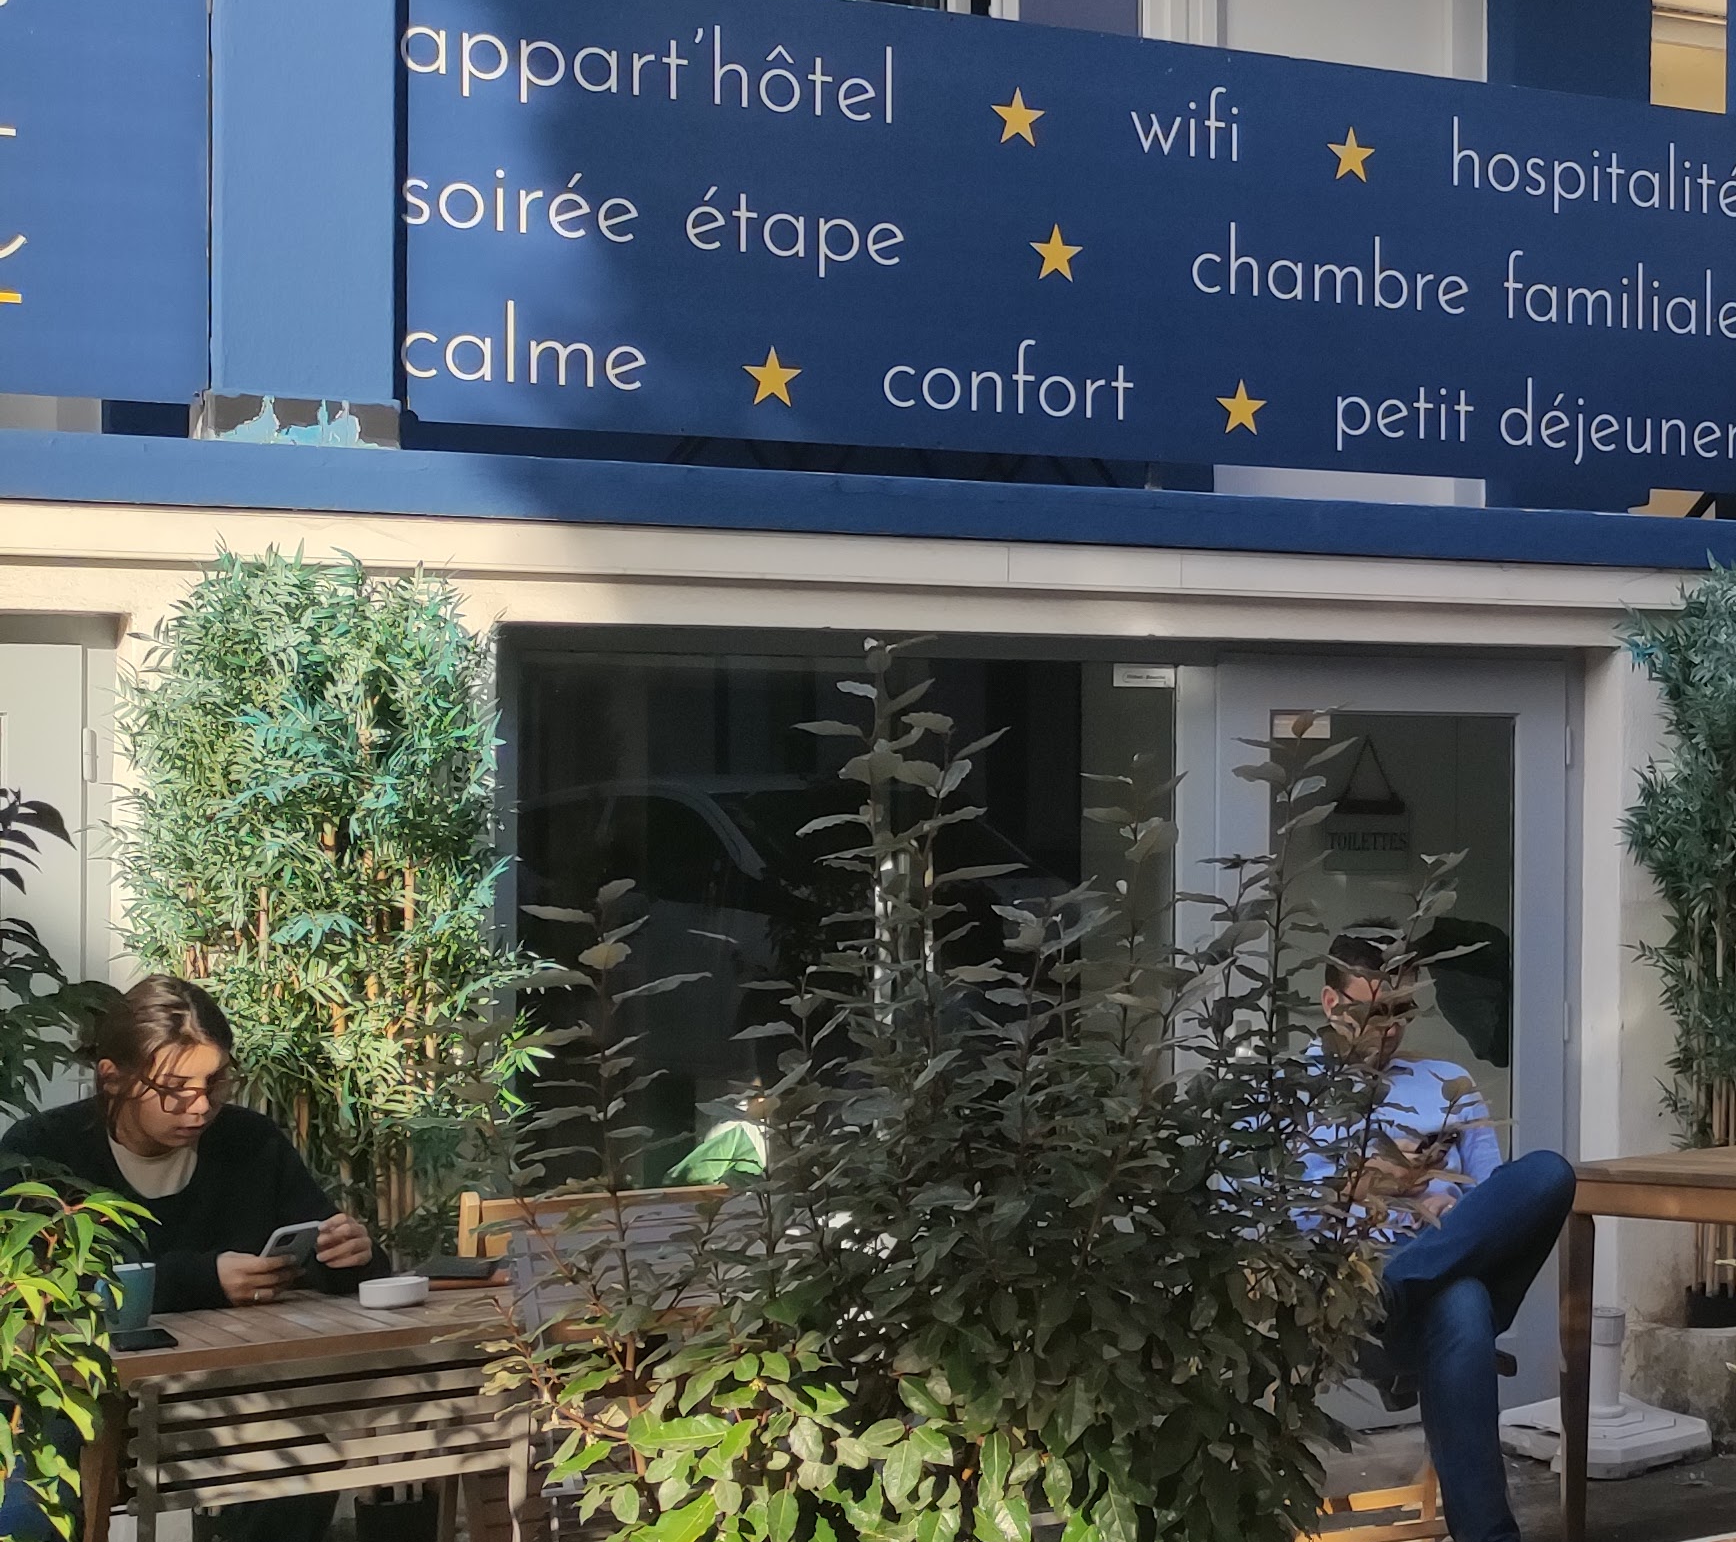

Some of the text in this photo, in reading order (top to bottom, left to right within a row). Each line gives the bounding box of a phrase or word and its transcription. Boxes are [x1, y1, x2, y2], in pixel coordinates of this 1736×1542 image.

[401, 25, 893, 123] appart'hôtel
[1131, 87, 1239, 161] wifi
[402, 169, 638, 242] soirée
[686, 186, 904, 277] étape
[1192, 222, 1468, 314] chambre
[401, 300, 646, 390] calme
[884, 339, 1133, 420] confort
[1337, 387, 1474, 451] petit
[1327, 832, 1407, 851] TOILETTES
